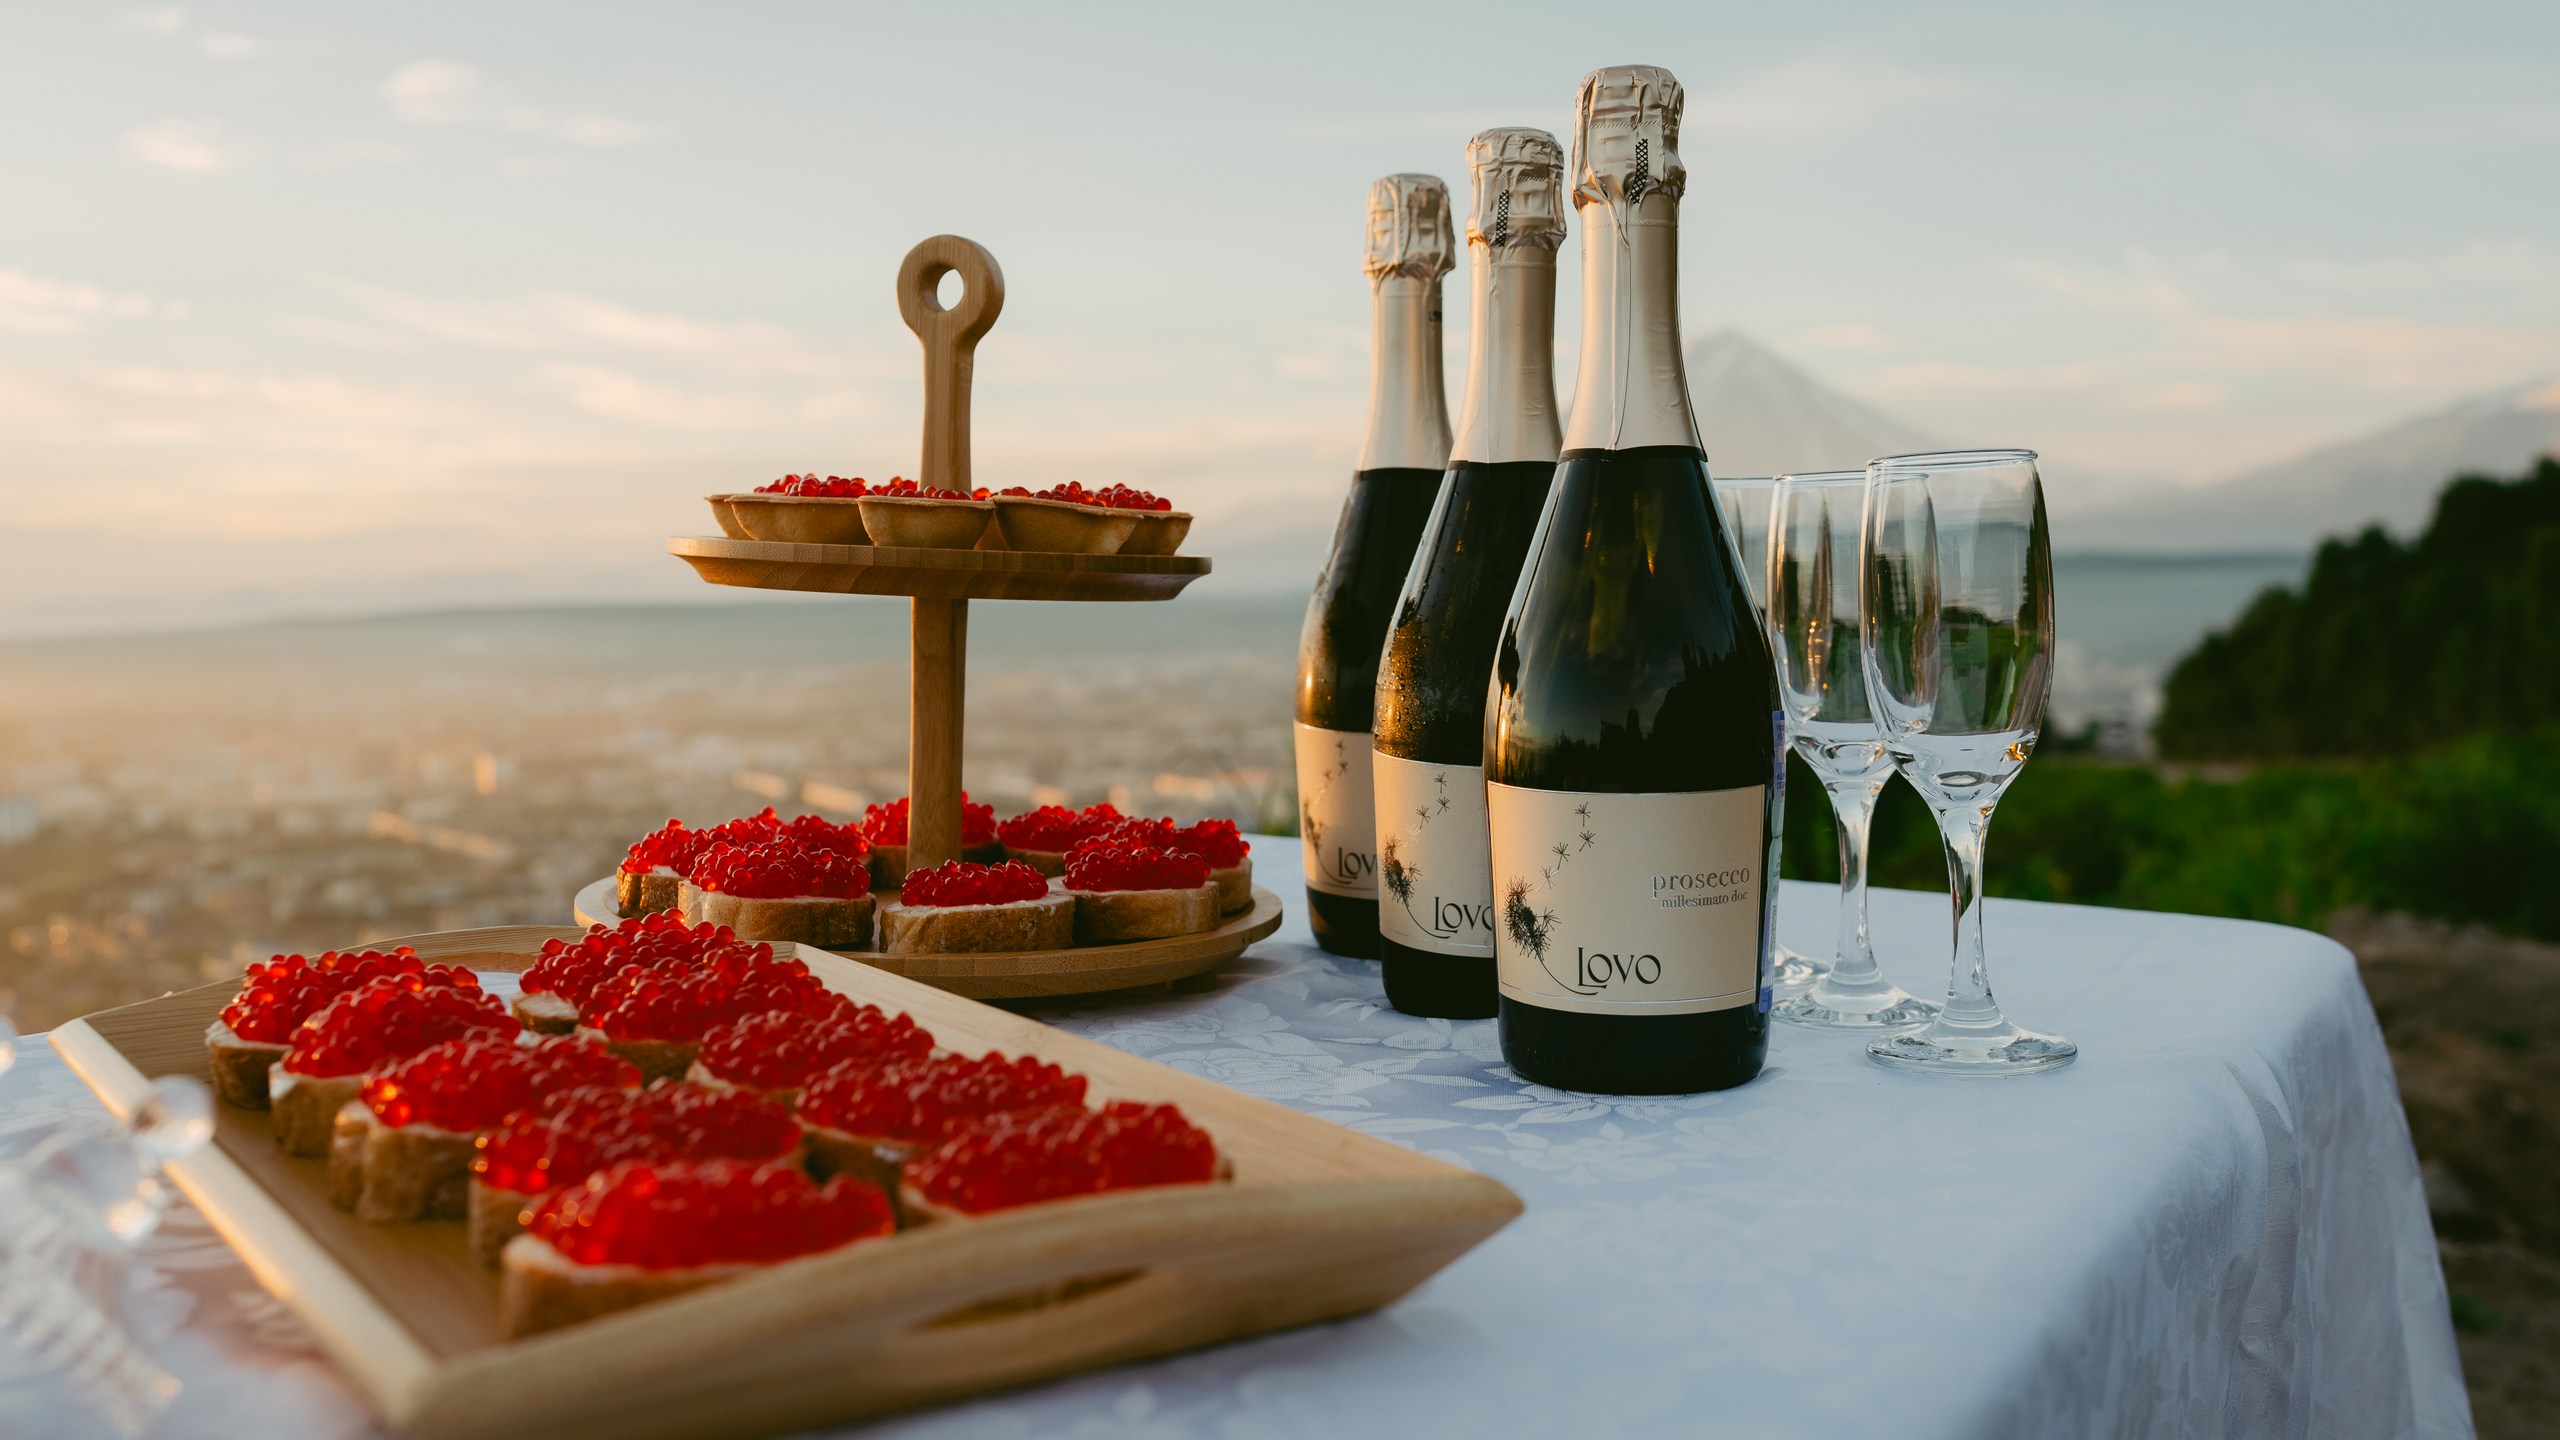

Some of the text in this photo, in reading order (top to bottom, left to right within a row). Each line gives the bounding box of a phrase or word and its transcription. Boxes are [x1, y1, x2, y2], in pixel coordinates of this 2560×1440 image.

[1338, 846, 1377, 880] LOV
[1651, 867, 1751, 899] prosecco
[1661, 889, 1748, 909] millesimato doc
